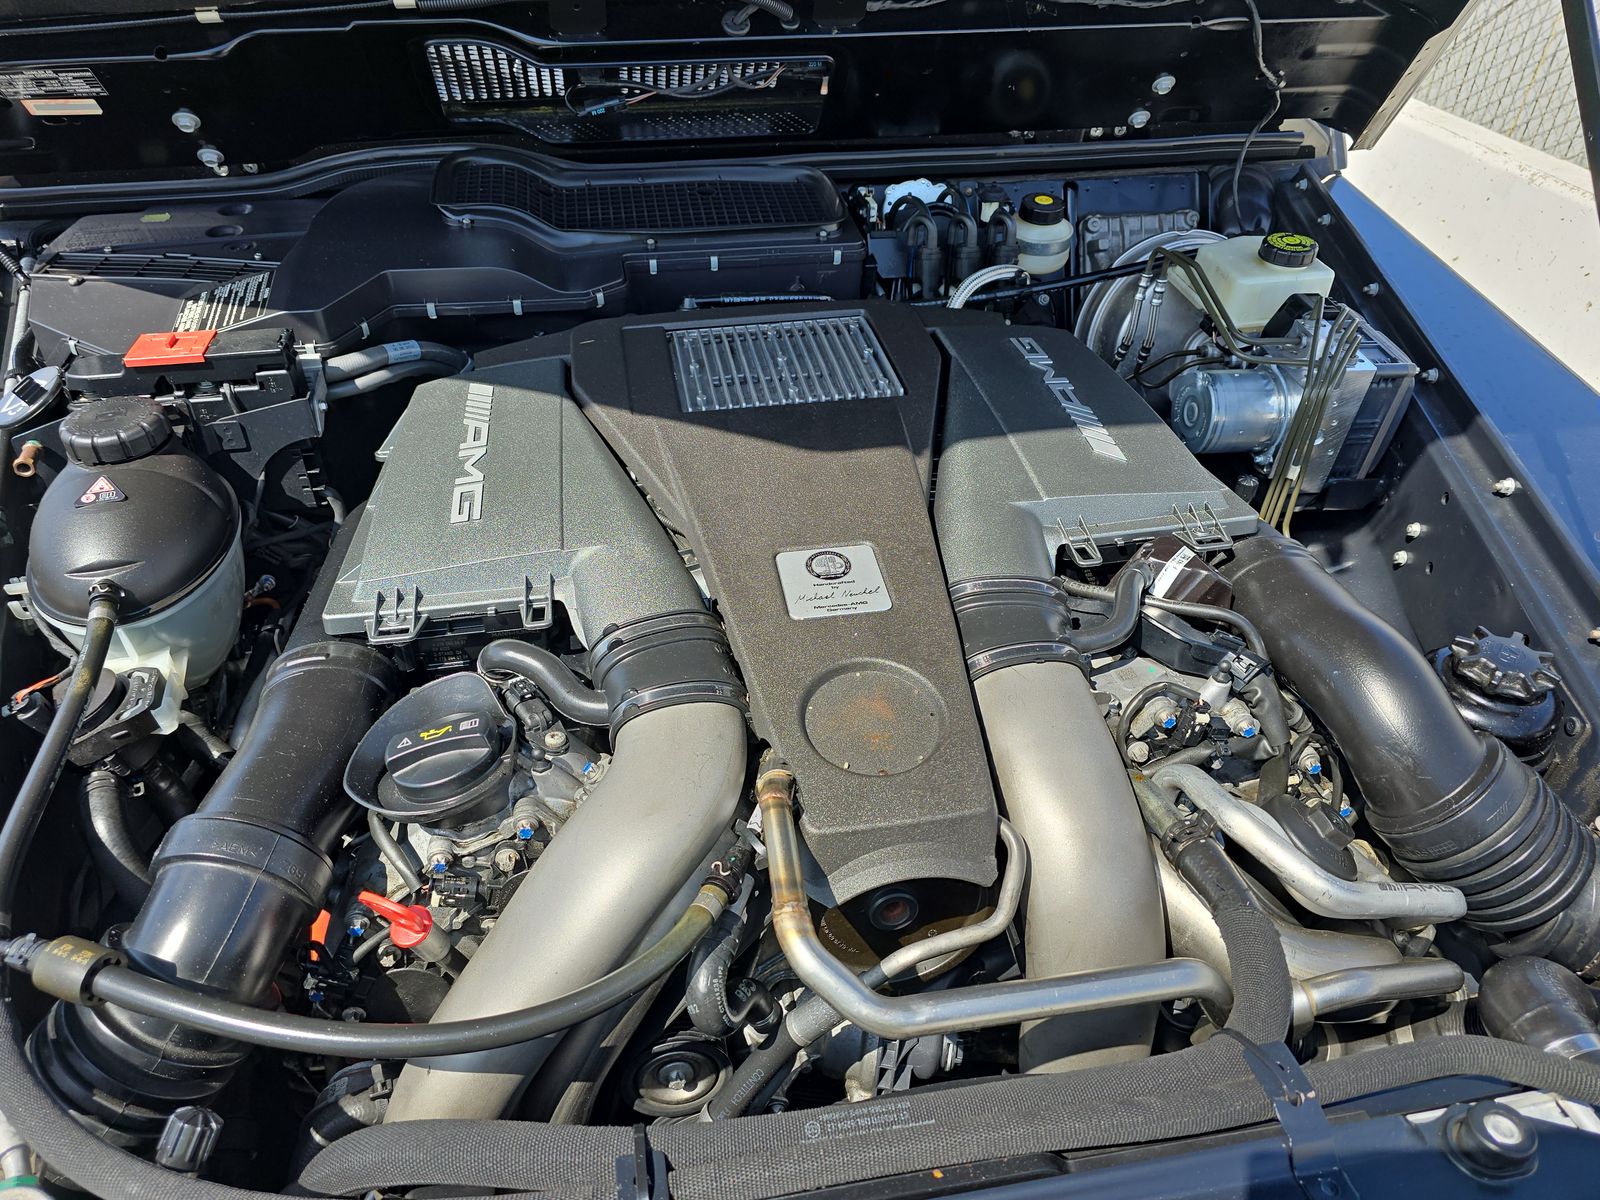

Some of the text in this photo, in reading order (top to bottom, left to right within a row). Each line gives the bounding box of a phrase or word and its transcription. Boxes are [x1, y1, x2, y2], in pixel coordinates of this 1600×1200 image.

[450, 418, 489, 525] AMG
[813, 600, 868, 609] Mercedes-AMG
[731, 1068, 765, 1106] CONTITECH
